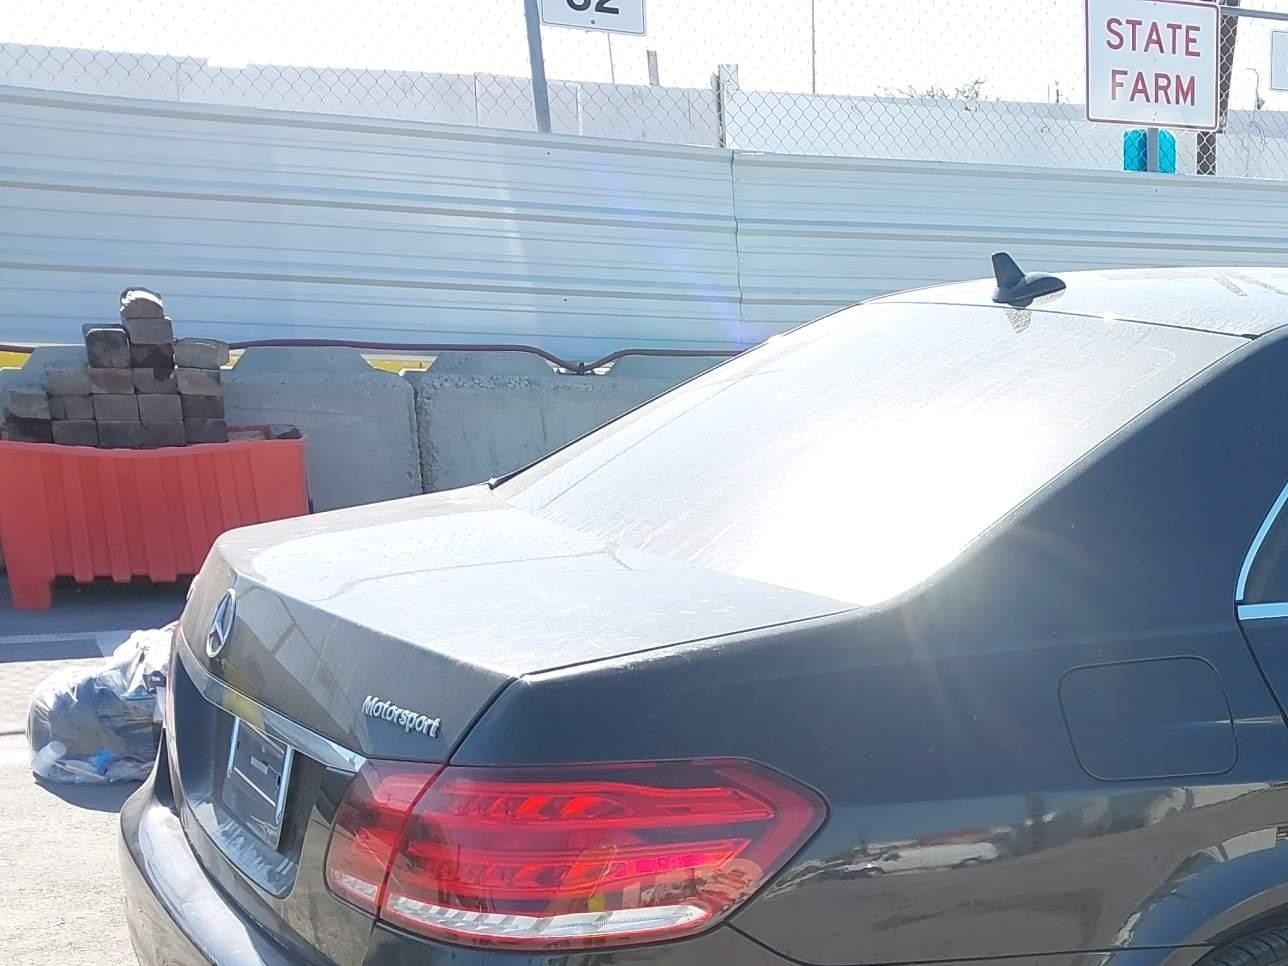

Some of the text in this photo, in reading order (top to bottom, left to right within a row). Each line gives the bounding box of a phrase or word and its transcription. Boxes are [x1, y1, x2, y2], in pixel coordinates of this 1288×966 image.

[1105, 17, 1201, 57] STATE
[1111, 69, 1196, 107] FARM
[361, 695, 441, 738] Motorsport
